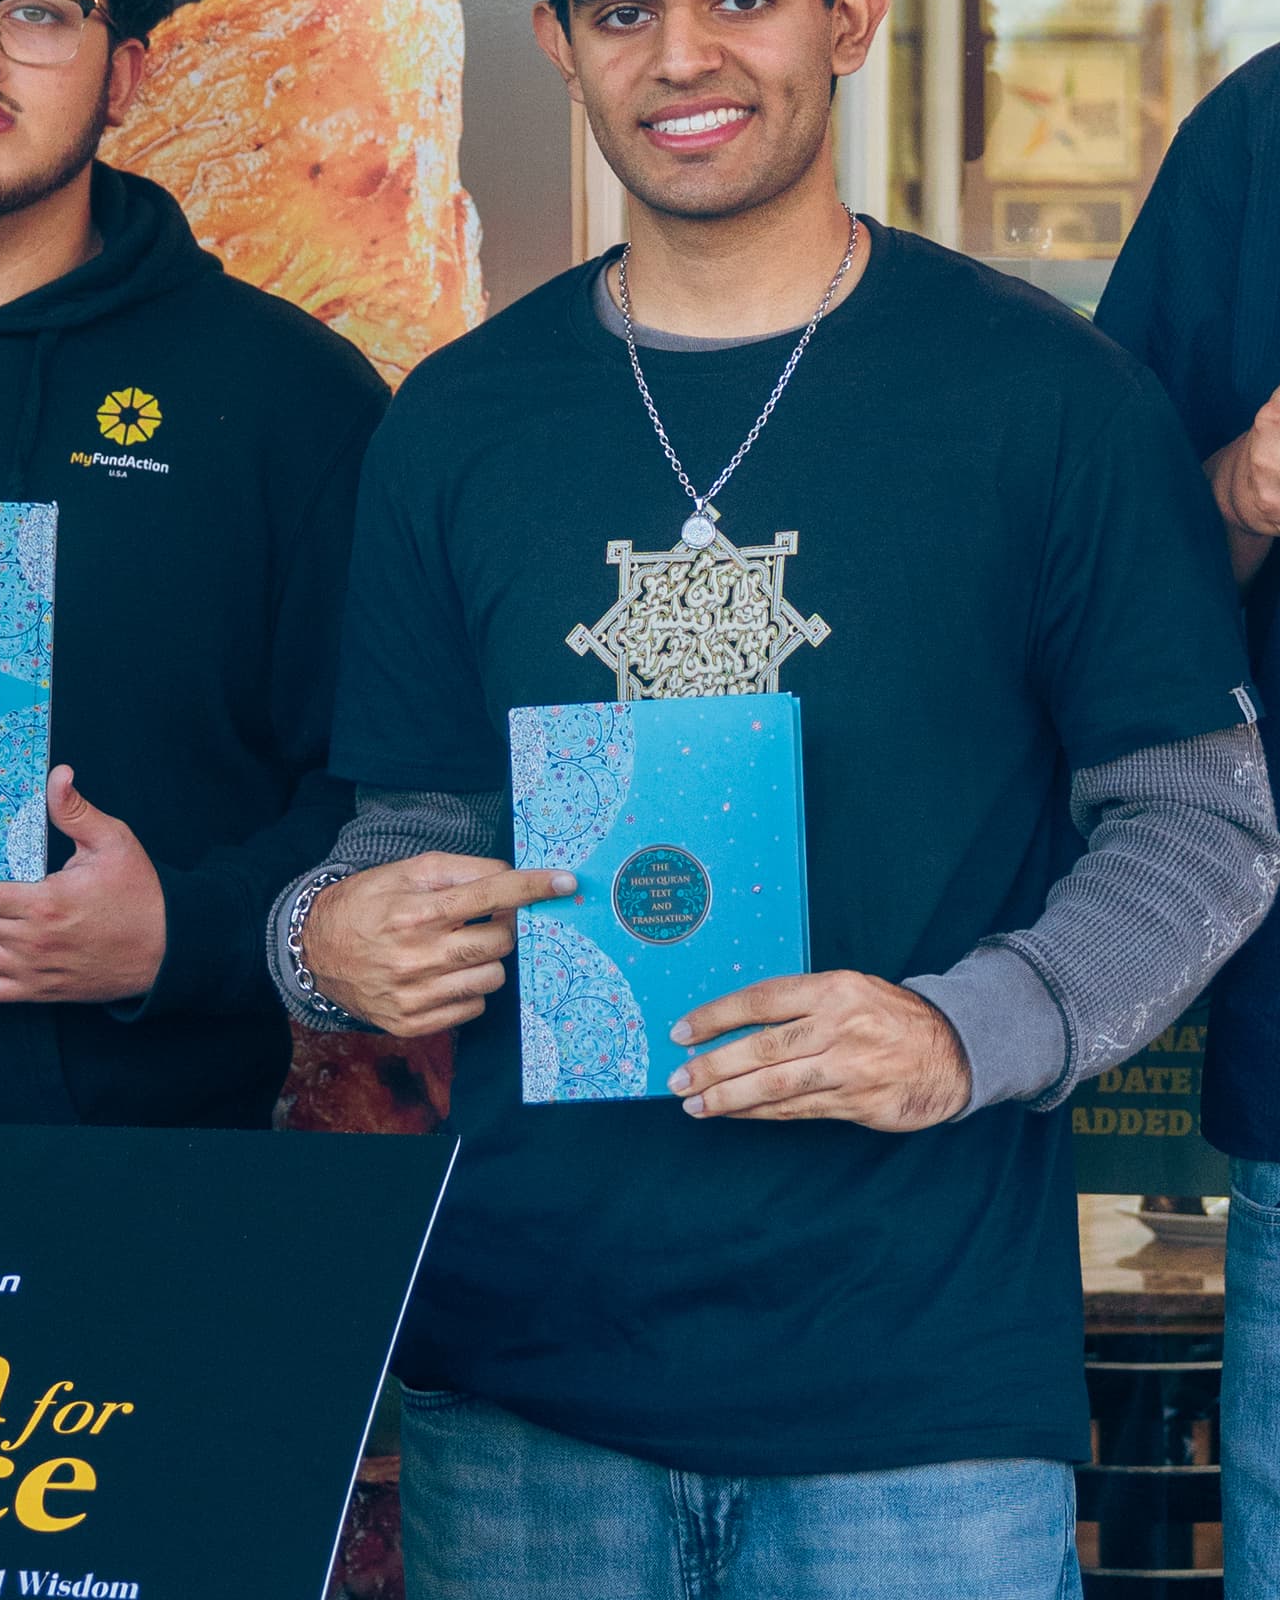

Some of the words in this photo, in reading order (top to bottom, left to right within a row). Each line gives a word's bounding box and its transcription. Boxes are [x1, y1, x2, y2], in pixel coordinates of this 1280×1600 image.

[70, 451, 169, 474] MyFundAction
[650, 863, 670, 872] THE
[630, 877, 654, 886] HOLY
[650, 888, 672, 898] TEXT
[651, 902, 672, 911] AND
[631, 913, 693, 925] TRANSLATION
[1072, 1107, 1193, 1137] ADDED
[1, 1381, 134, 1451] for
[18, 1570, 140, 1600] Wisdom
